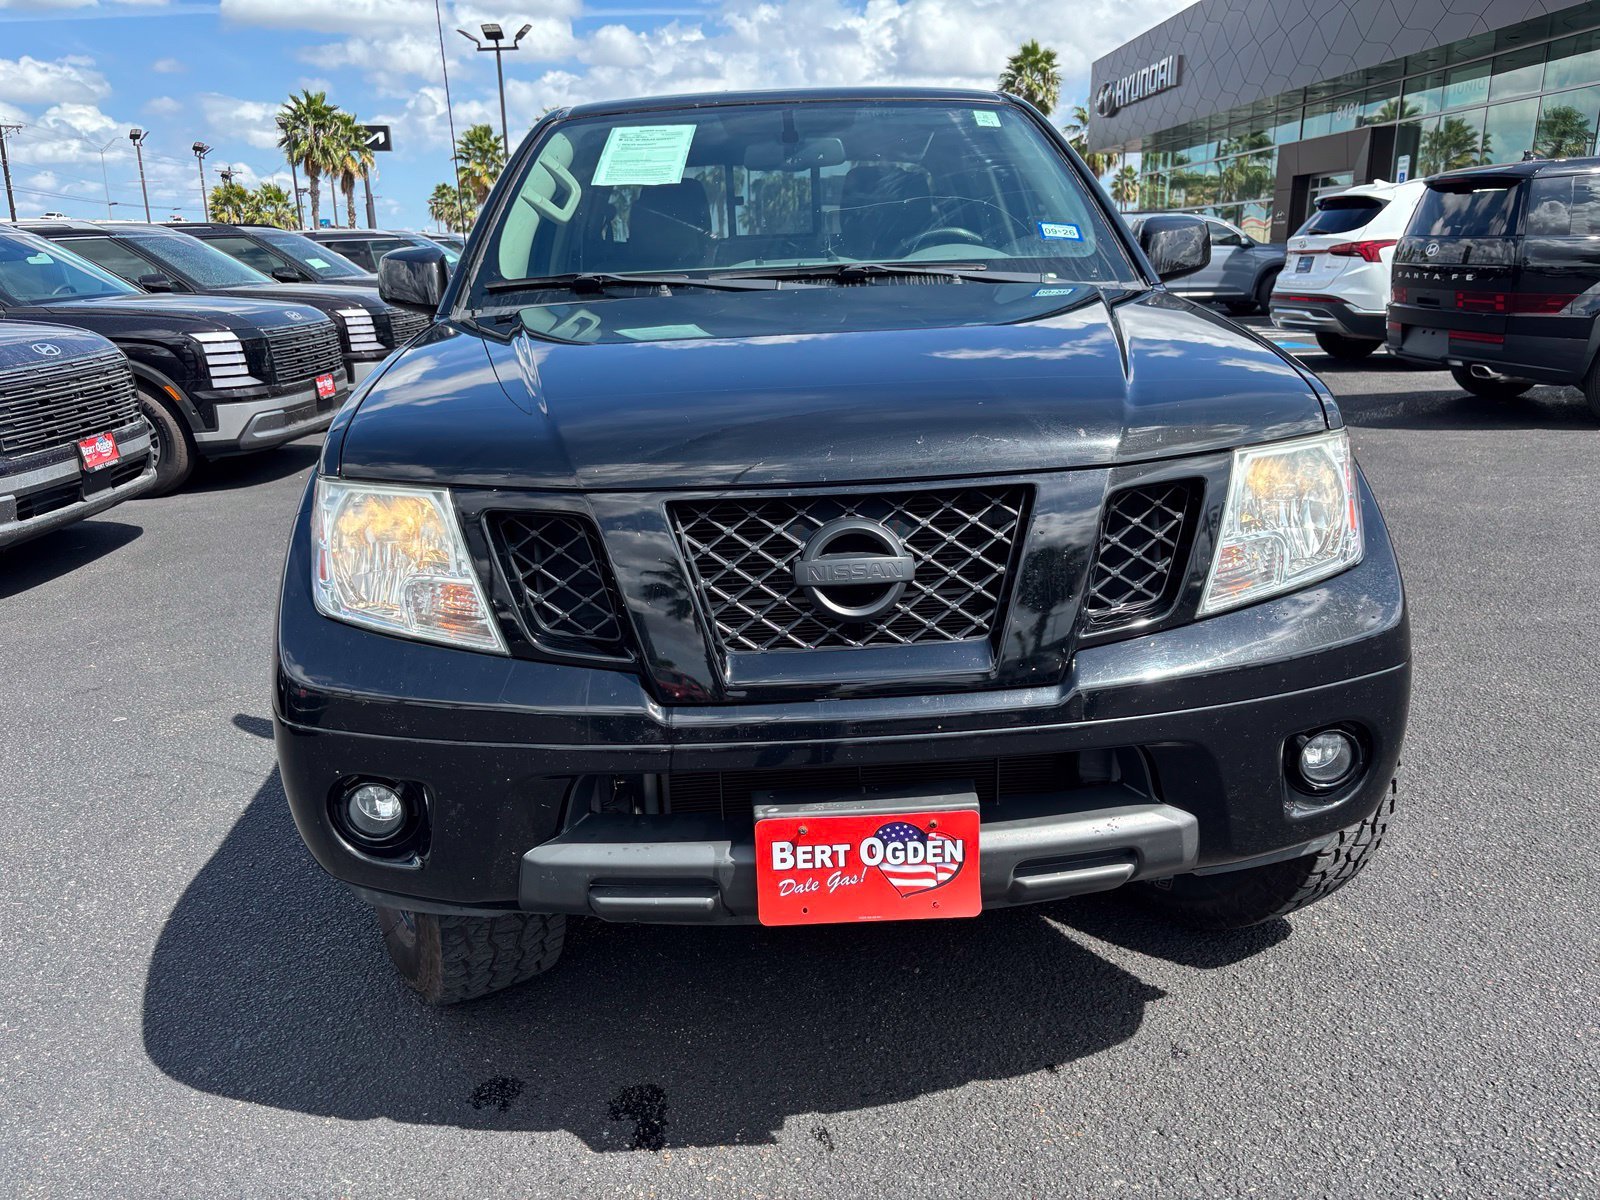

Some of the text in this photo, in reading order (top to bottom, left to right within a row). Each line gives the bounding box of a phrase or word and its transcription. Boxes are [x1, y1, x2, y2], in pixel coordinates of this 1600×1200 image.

[1115, 55, 1173, 108] HYUNDAI
[1336, 101, 1360, 121] 8421
[1397, 271, 1474, 281] SANTA FE
[807, 561, 904, 582] NISSAN
[771, 836, 964, 871] BERT OGDEN
[778, 867, 868, 897] Dale Gas!
